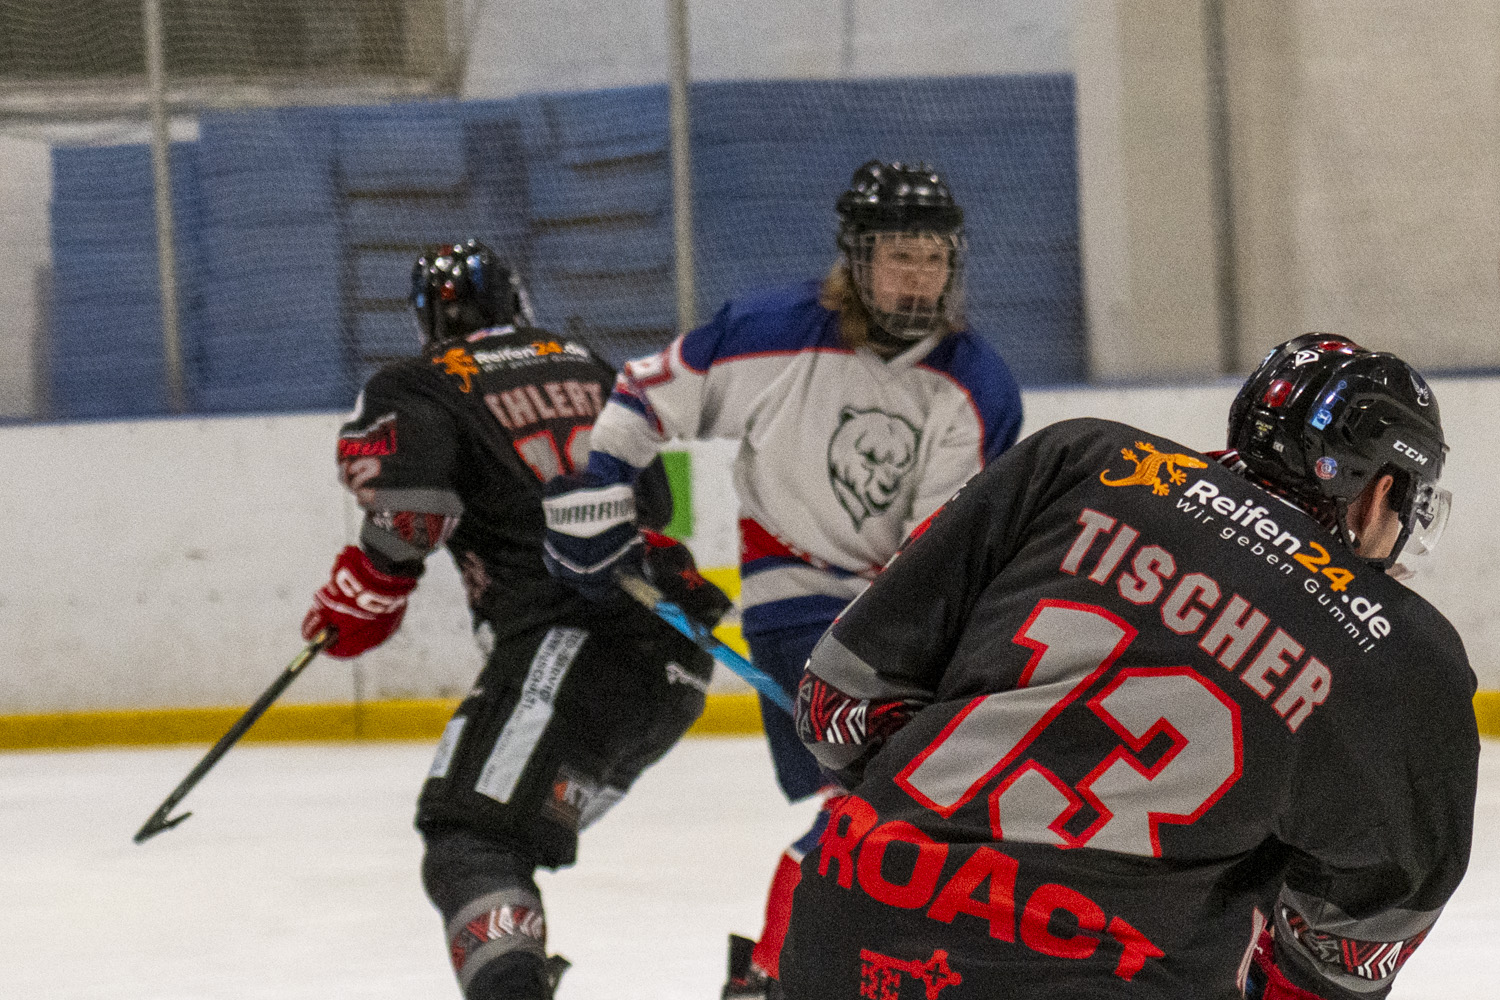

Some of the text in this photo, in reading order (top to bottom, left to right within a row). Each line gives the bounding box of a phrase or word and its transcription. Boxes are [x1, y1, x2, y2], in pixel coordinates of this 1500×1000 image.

[1391, 439, 1429, 466] CCM
[1059, 507, 1333, 733] TISCHER
[1175, 497, 1376, 653] Wir geben Gummi!
[1183, 479, 1392, 640] Reifen24.de
[893, 598, 1245, 859] 13
[818, 795, 1166, 983] ROACT
